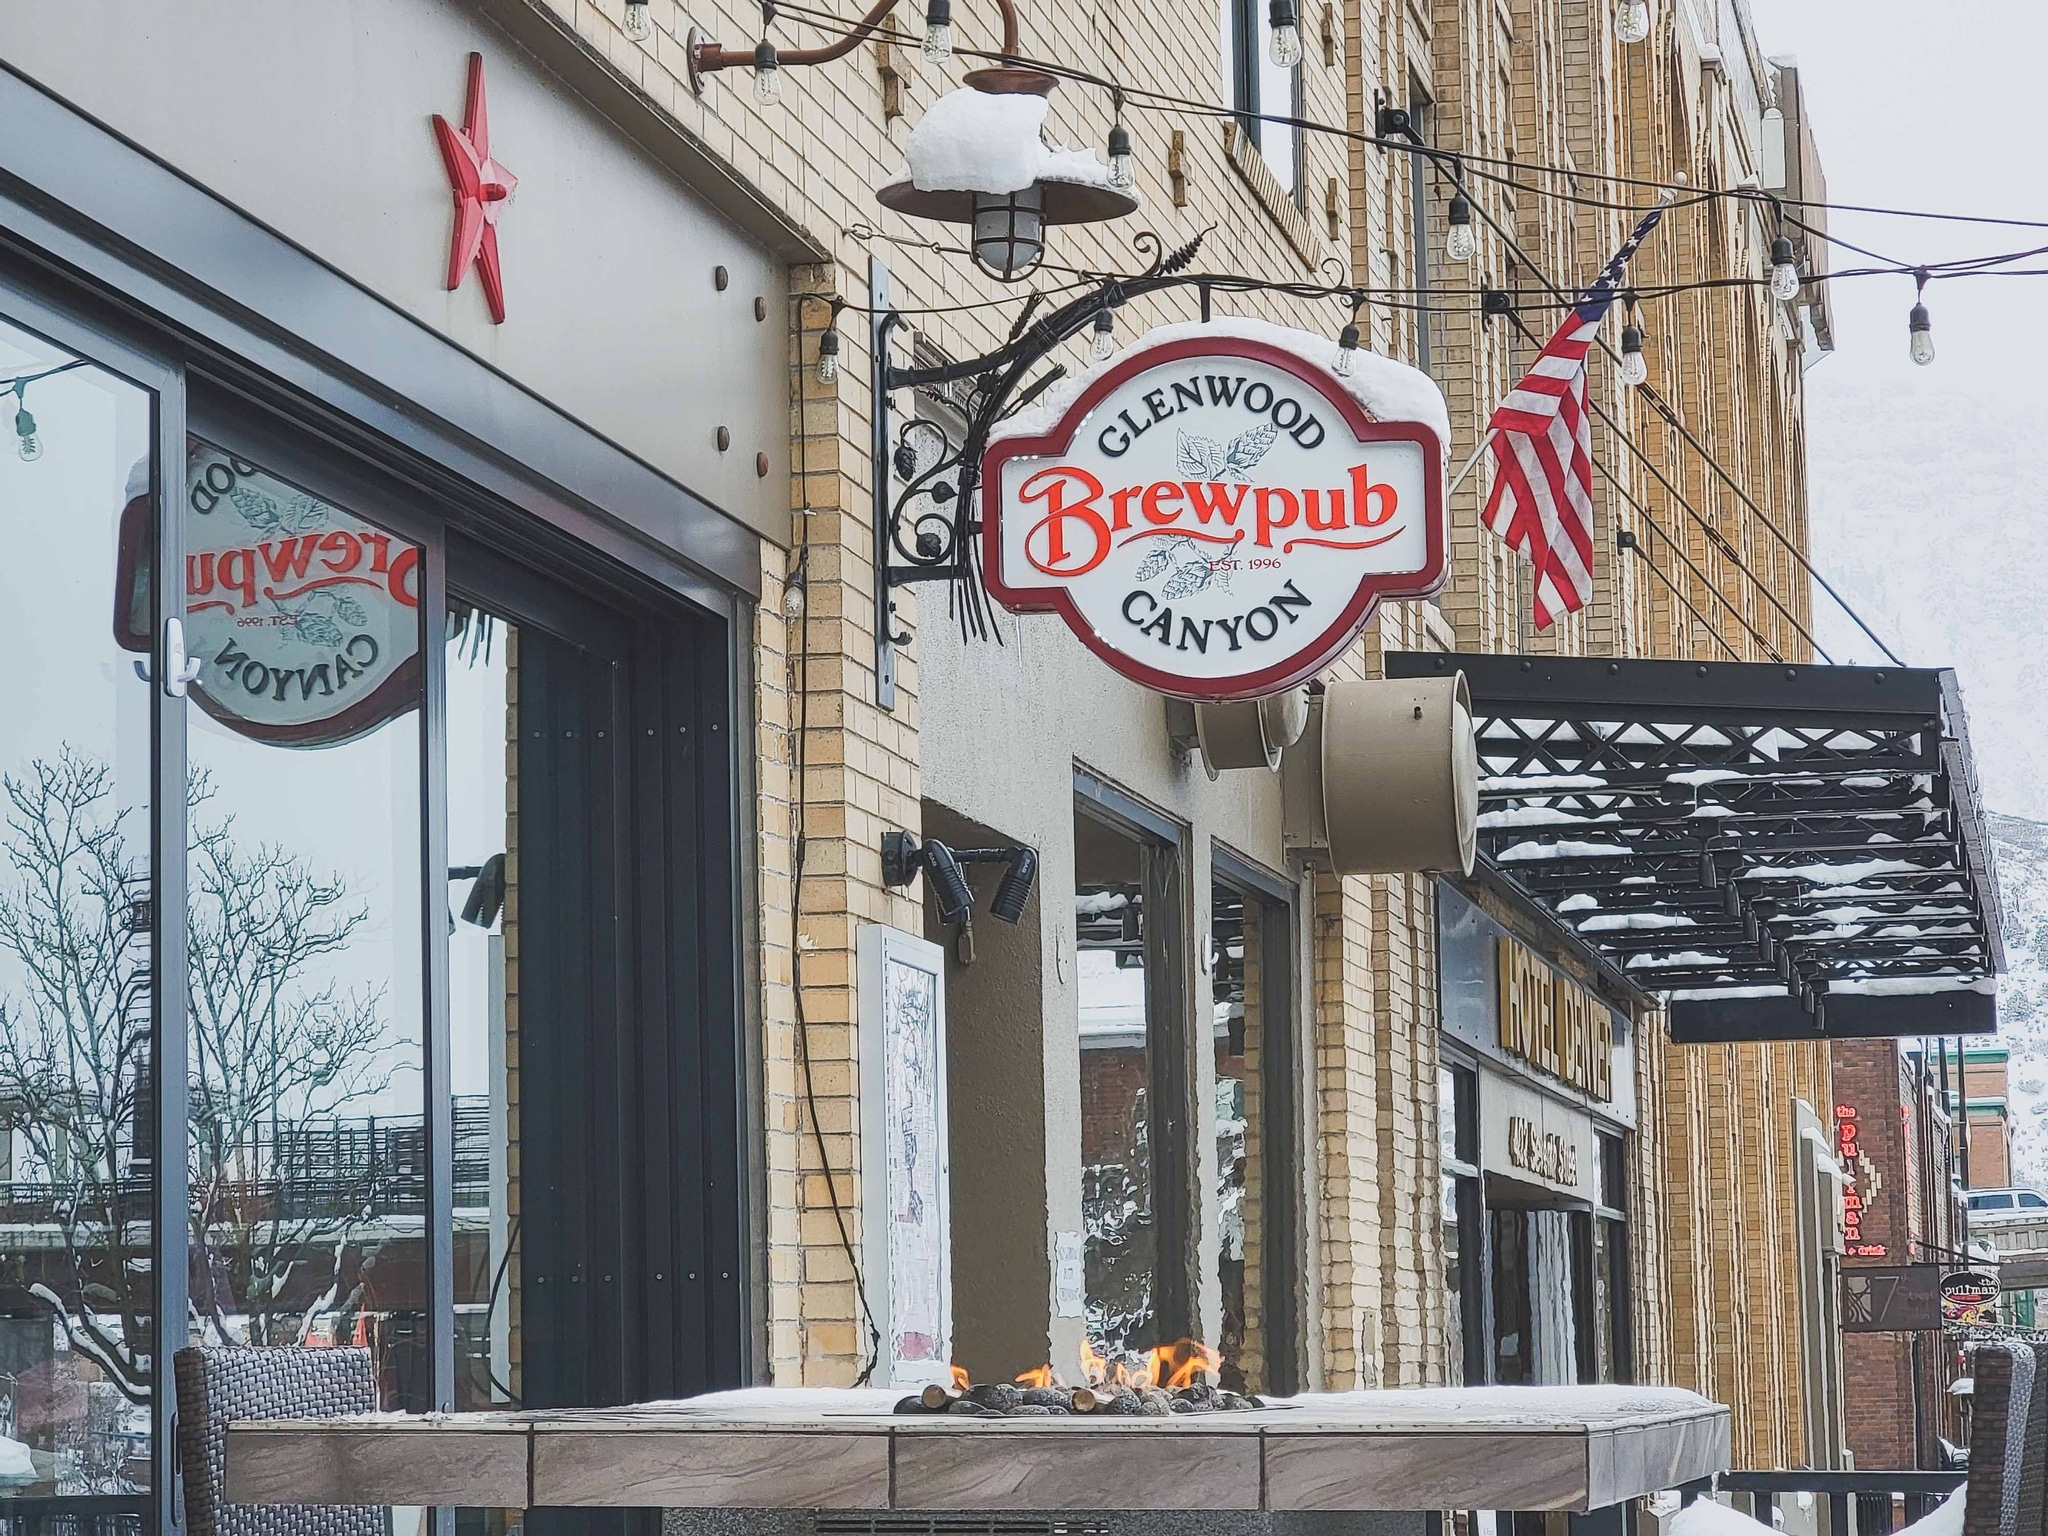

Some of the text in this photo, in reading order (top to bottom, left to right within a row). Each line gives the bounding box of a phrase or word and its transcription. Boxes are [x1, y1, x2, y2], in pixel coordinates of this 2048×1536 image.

[1098, 374, 1326, 458] GLENWOOD
[1018, 463, 1402, 577] Brewpub
[1209, 558, 1282, 572] EST. 1996
[1122, 579, 1312, 653] CANYON
[1499, 936, 1613, 1104] HOTEL DENVER
[1836, 1105, 1856, 1118] the
[1945, 1285, 1998, 1297] pullman
